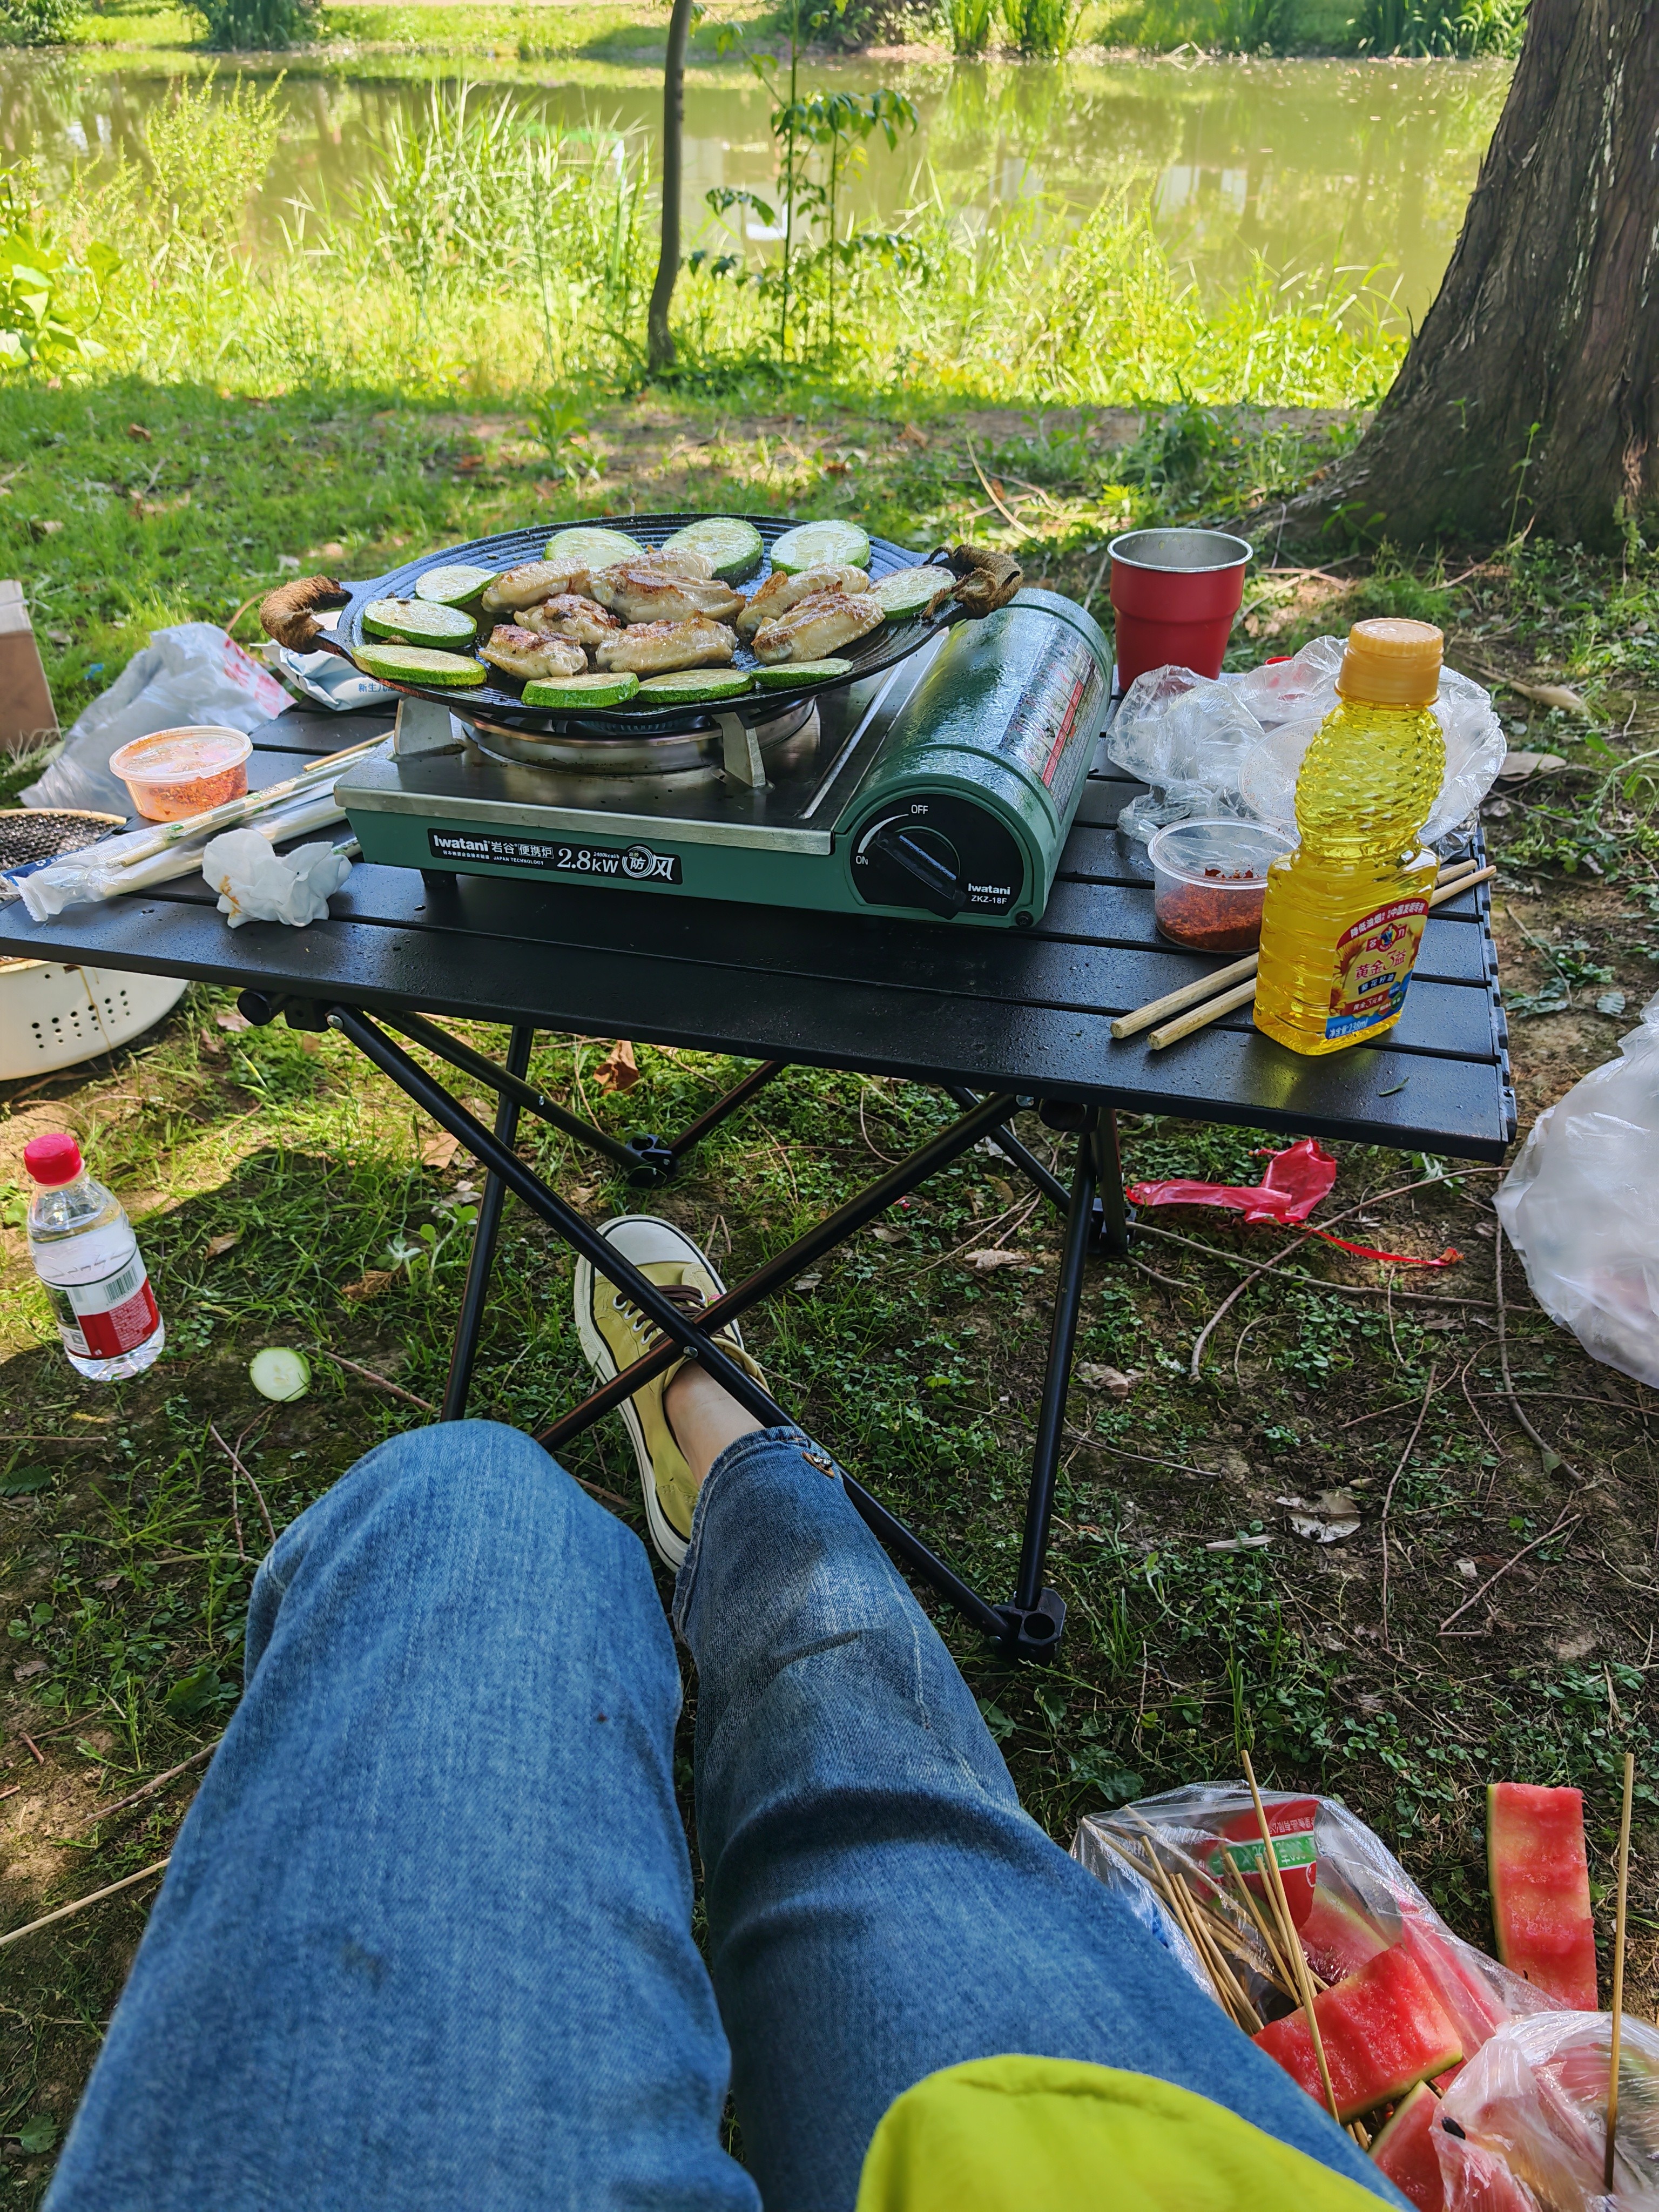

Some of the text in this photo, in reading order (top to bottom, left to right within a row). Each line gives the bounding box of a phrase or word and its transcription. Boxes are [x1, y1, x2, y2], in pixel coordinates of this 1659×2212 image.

[911, 805, 929, 814] OFF
[434, 835, 552, 857] Iwatani 岩谷 便携炉
[855, 856, 868, 865] ON
[968, 883, 1011, 895] Iwatani
[971, 895, 1008, 905] ZKZ-18F
